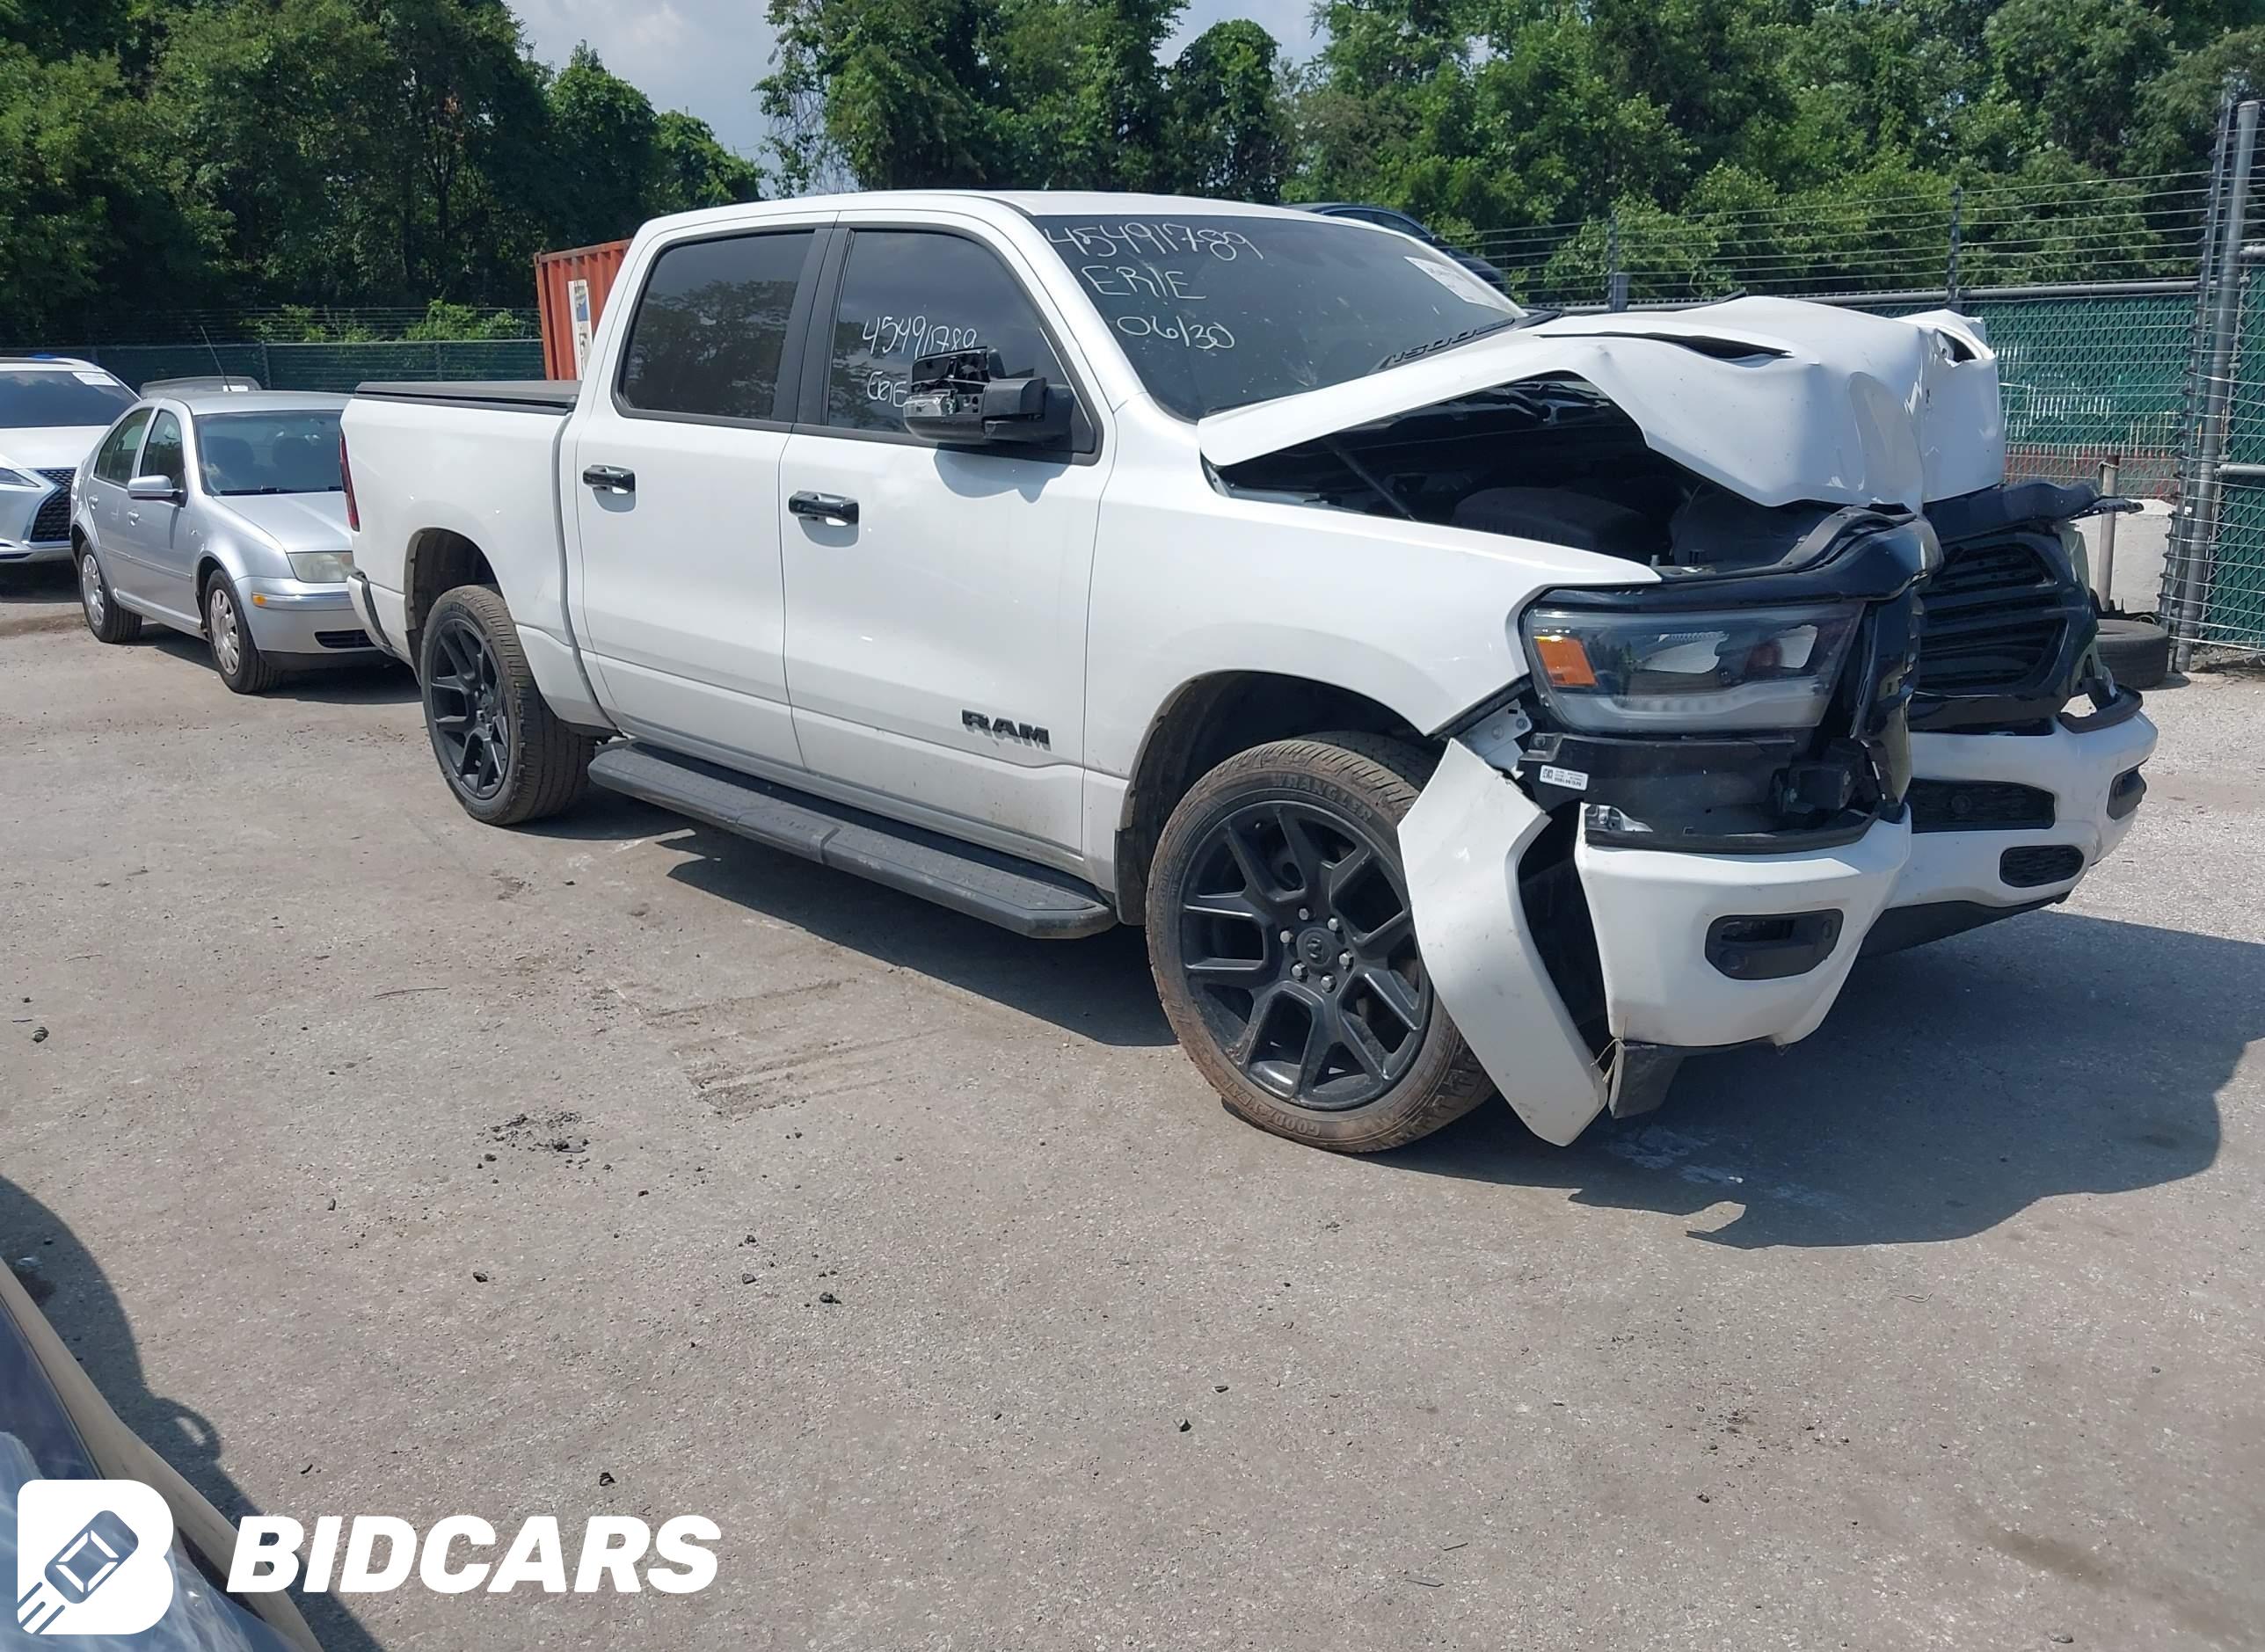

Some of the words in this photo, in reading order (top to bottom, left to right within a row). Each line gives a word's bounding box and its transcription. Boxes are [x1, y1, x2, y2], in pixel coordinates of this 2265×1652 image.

[1044, 222, 1264, 261] 45491789
[1081, 265, 1207, 300] ERIE
[1116, 315, 1235, 350] 06/30
[961, 709, 1050, 746] RAM
[1272, 771, 1373, 823] WRANGLER
